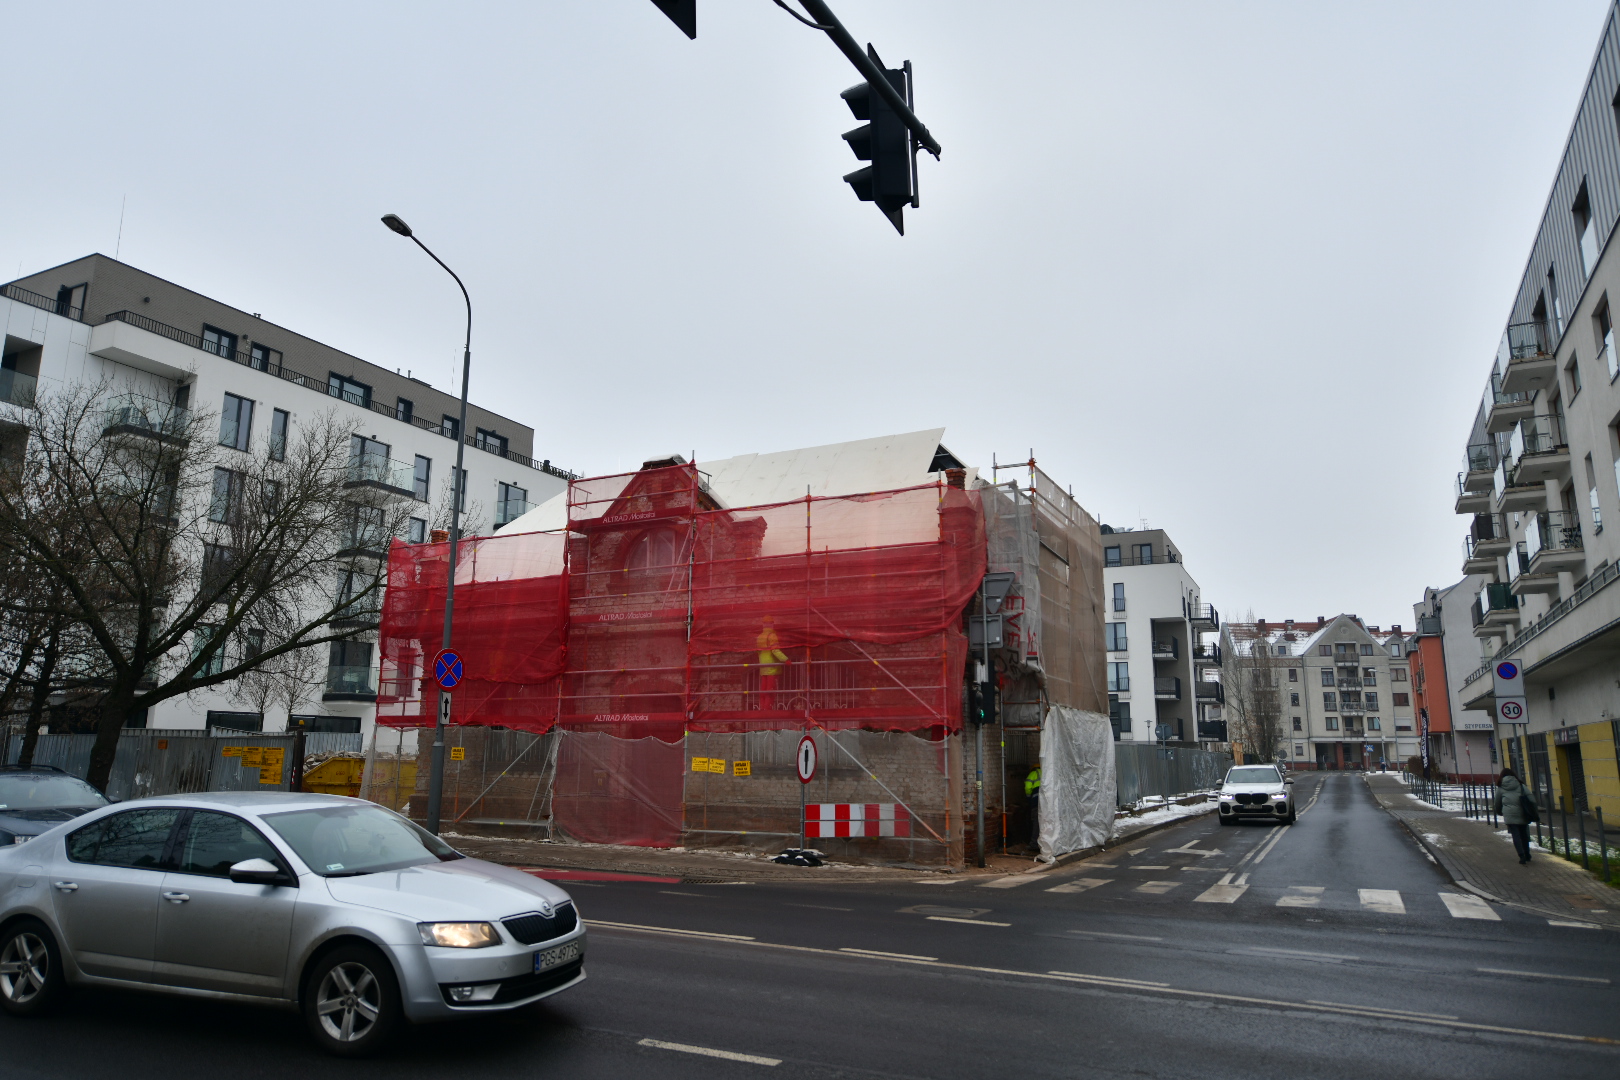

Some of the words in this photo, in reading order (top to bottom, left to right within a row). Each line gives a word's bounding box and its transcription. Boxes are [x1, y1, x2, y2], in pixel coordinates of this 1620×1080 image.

[602, 515, 628, 523] ALTRAD
[598, 613, 624, 621] ALTRAD
[1504, 705, 1520, 715] 30
[594, 714, 621, 722] ALTRAD
[540, 950, 556, 967] PGS
